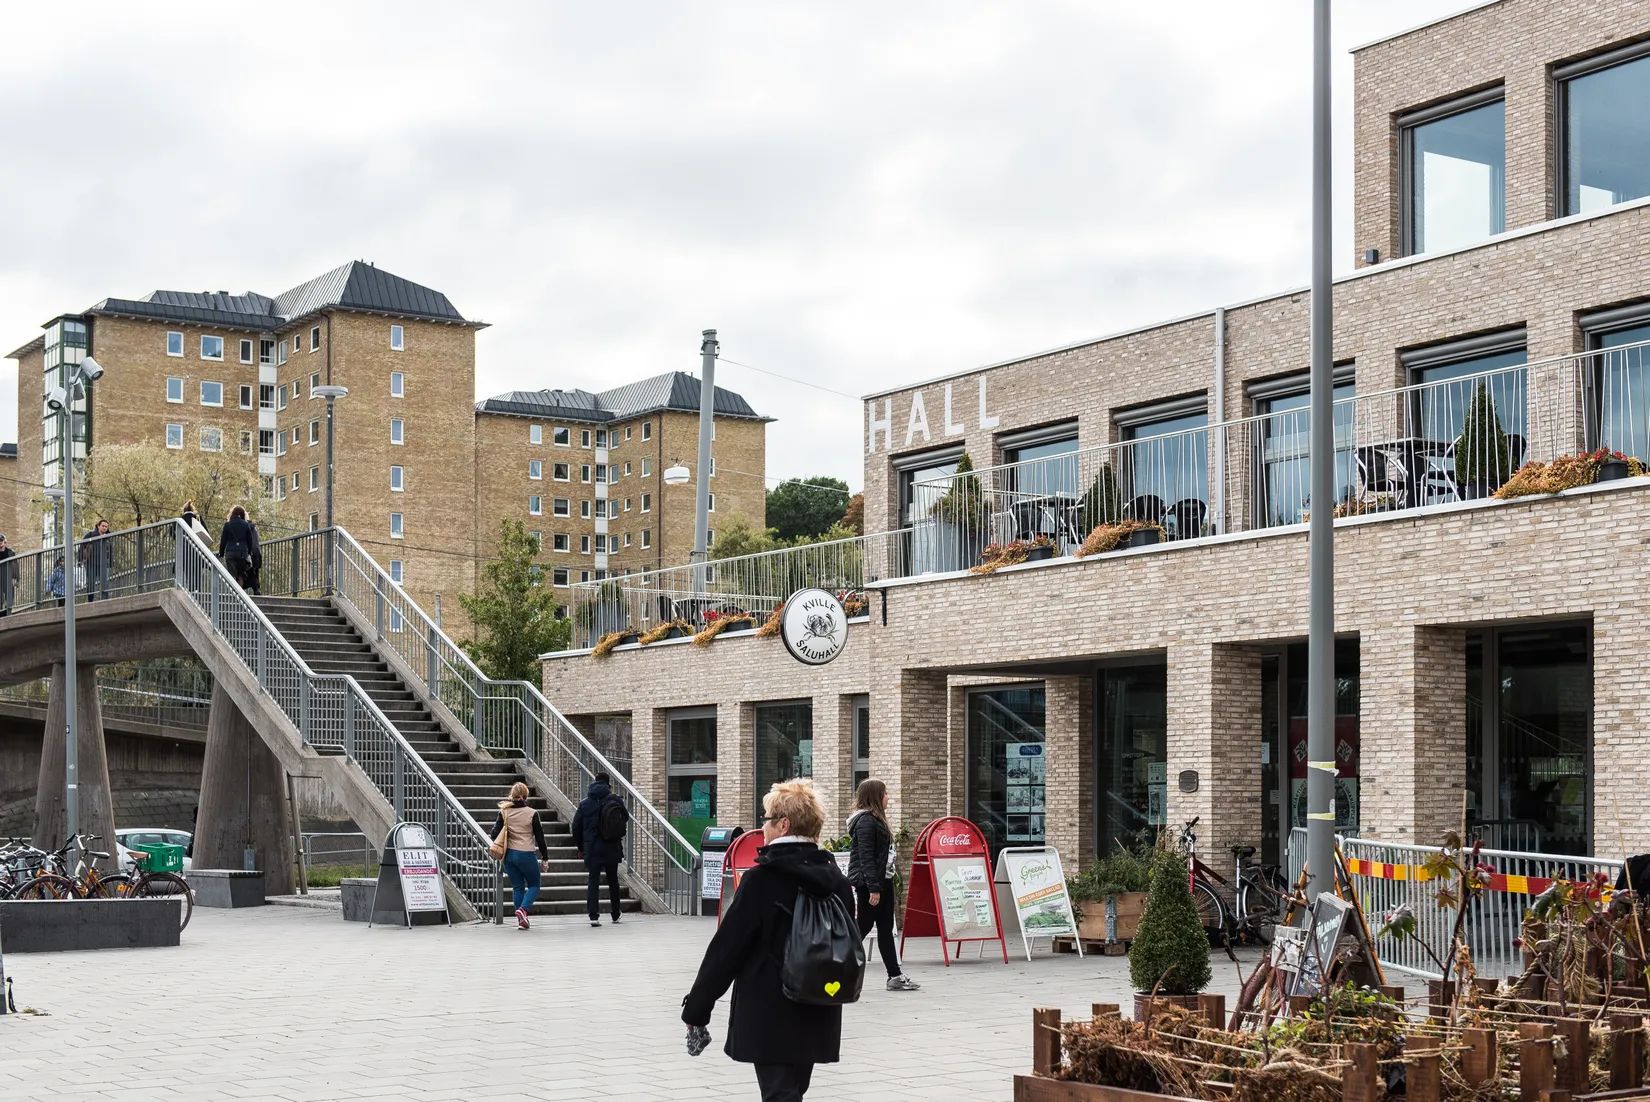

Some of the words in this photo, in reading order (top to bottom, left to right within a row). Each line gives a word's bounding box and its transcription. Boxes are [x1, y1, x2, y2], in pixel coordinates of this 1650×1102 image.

[868, 375, 1000, 453] HALL
[802, 598, 836, 612] KVILLE
[796, 639, 840, 660] SALUHALL
[939, 833, 971, 847] Coca-Cola
[402, 851, 428, 860] ELIT
[704, 860, 723, 868] metro
